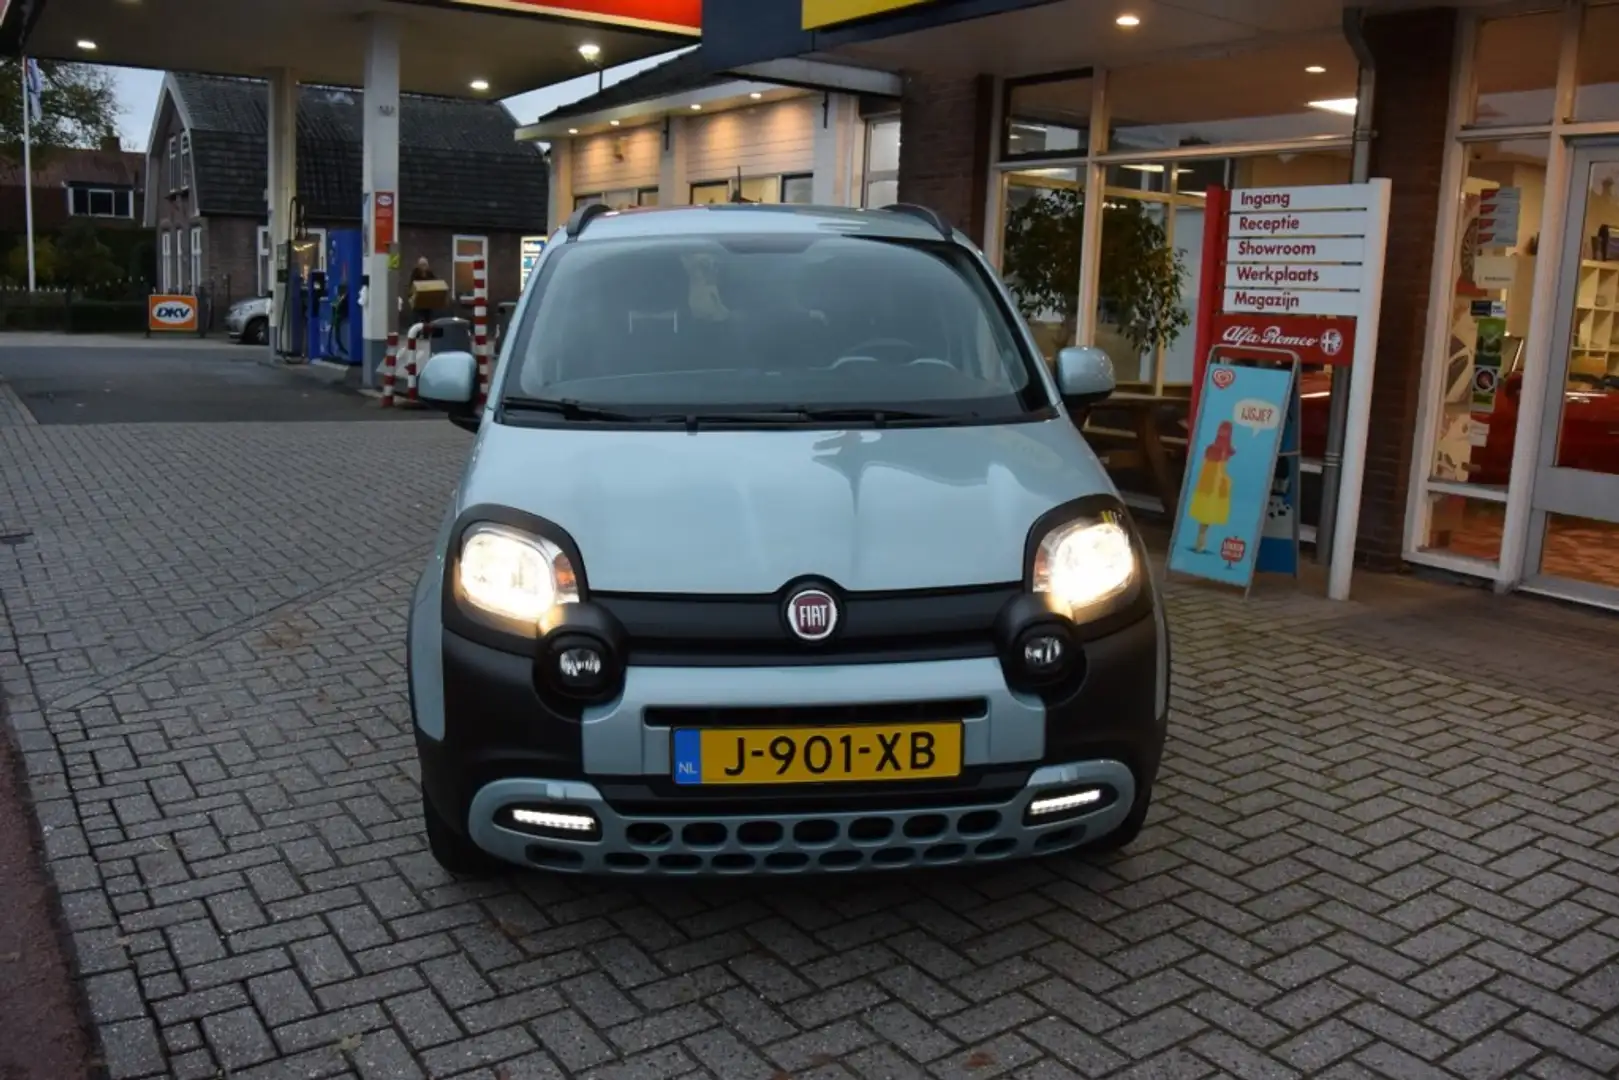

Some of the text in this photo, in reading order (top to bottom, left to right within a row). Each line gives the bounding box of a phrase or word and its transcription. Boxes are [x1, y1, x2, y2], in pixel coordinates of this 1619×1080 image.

[1240, 191, 1291, 209] Ingang
[1238, 214, 1300, 234] Receptie
[1237, 240, 1316, 256] Showroom
[1236, 265, 1320, 284] Werkplaats
[1233, 291, 1300, 310] Magazijn
[156, 307, 190, 319] DKV
[1222, 325, 1318, 346] Alfa Romeo
[799, 604, 828, 628] FIAT
[724, 731, 937, 776] J-901-XB
[678, 761, 698, 775] NL
